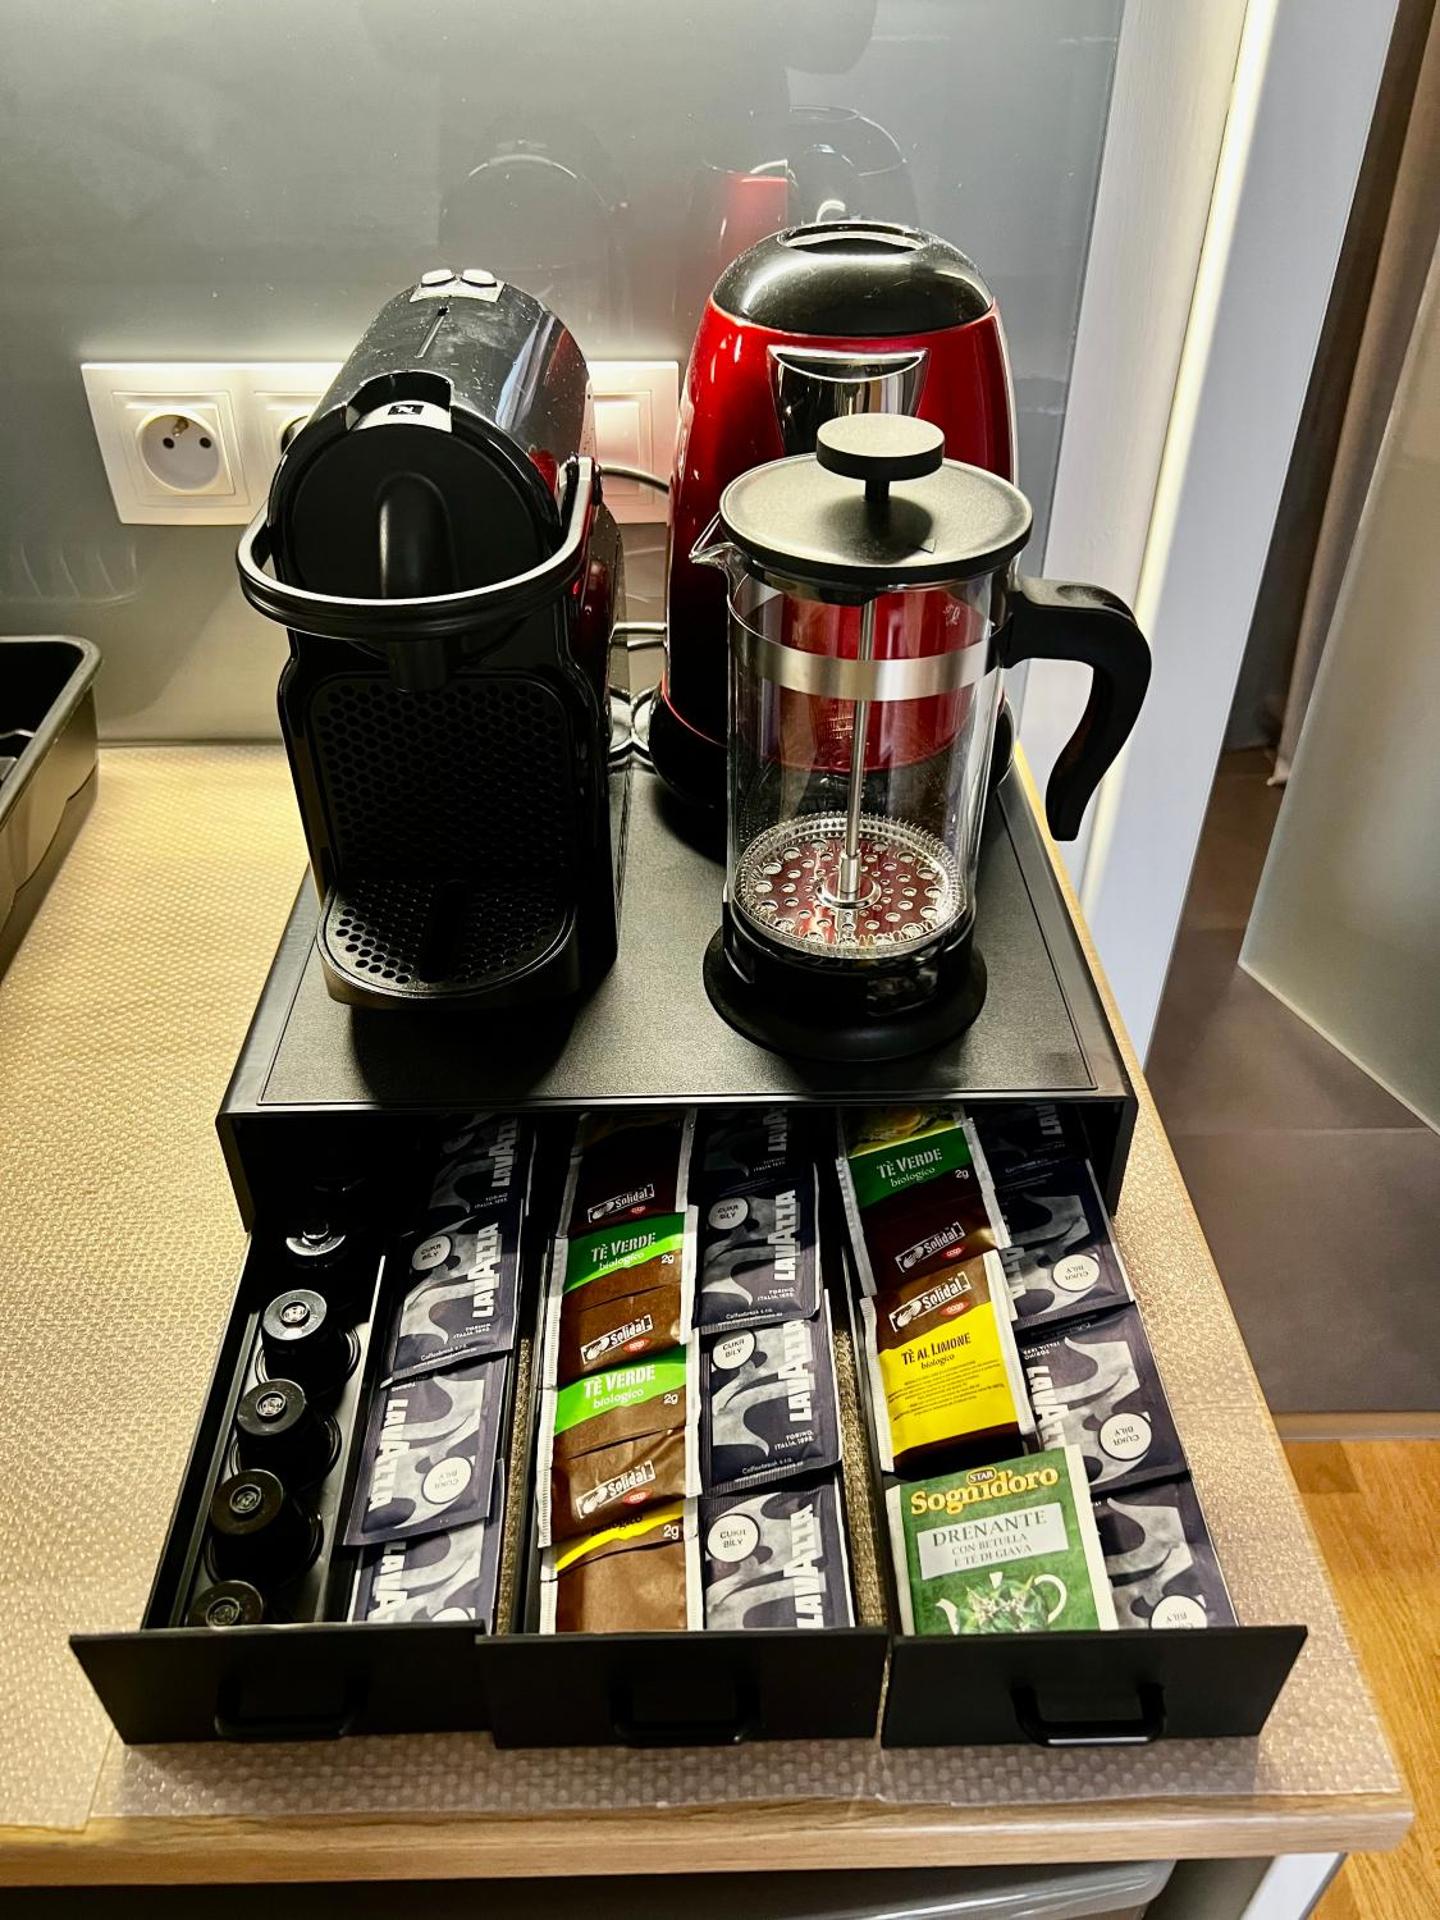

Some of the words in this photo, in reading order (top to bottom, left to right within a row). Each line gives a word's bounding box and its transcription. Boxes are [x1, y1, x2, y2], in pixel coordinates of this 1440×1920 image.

[877, 1161, 896, 1178] TÈ
[896, 1148, 943, 1172] VERDE
[955, 1169, 969, 1179] 2g
[890, 1168, 936, 1187] biologico
[615, 1188, 648, 1209] Solidal
[591, 1244, 607, 1262] TÈ
[611, 1232, 656, 1256] VERDE
[767, 1190, 796, 1281] LAVAZZA
[924, 1228, 958, 1253] Solidal
[467, 1222, 499, 1318] LAVAZZA
[599, 1251, 645, 1270] biologico
[661, 1255, 674, 1265] 2g
[922, 1278, 962, 1309] Solidal
[946, 1302, 964, 1313] coop
[611, 1319, 646, 1345] Solidal
[901, 1348, 915, 1365] TÈ
[931, 1333, 972, 1356] LIMONE
[921, 1354, 955, 1369] biologico
[584, 1378, 601, 1398] TÈ
[606, 1364, 656, 1390] VERDE
[777, 1320, 812, 1421] LAVAZZA
[593, 1388, 644, 1409] biologico
[664, 1393, 678, 1404] 2g
[1026, 1366, 1069, 1448] LAVAZZ
[368, 1400, 410, 1512] LAVAZZA
[607, 1467, 647, 1496] Solidal
[970, 1470, 995, 1482] STAR
[663, 1524, 679, 1540] 2g
[932, 1510, 1047, 1547] DRENANTE
[952, 1544, 976, 1556] CON
[978, 1534, 1028, 1551] BETULLA
[980, 1550, 992, 1562] DI
[994, 1545, 1033, 1560] GIAVA
[783, 1504, 824, 1628] LAVAZZA
[367, 1541, 407, 1622] LAVA
